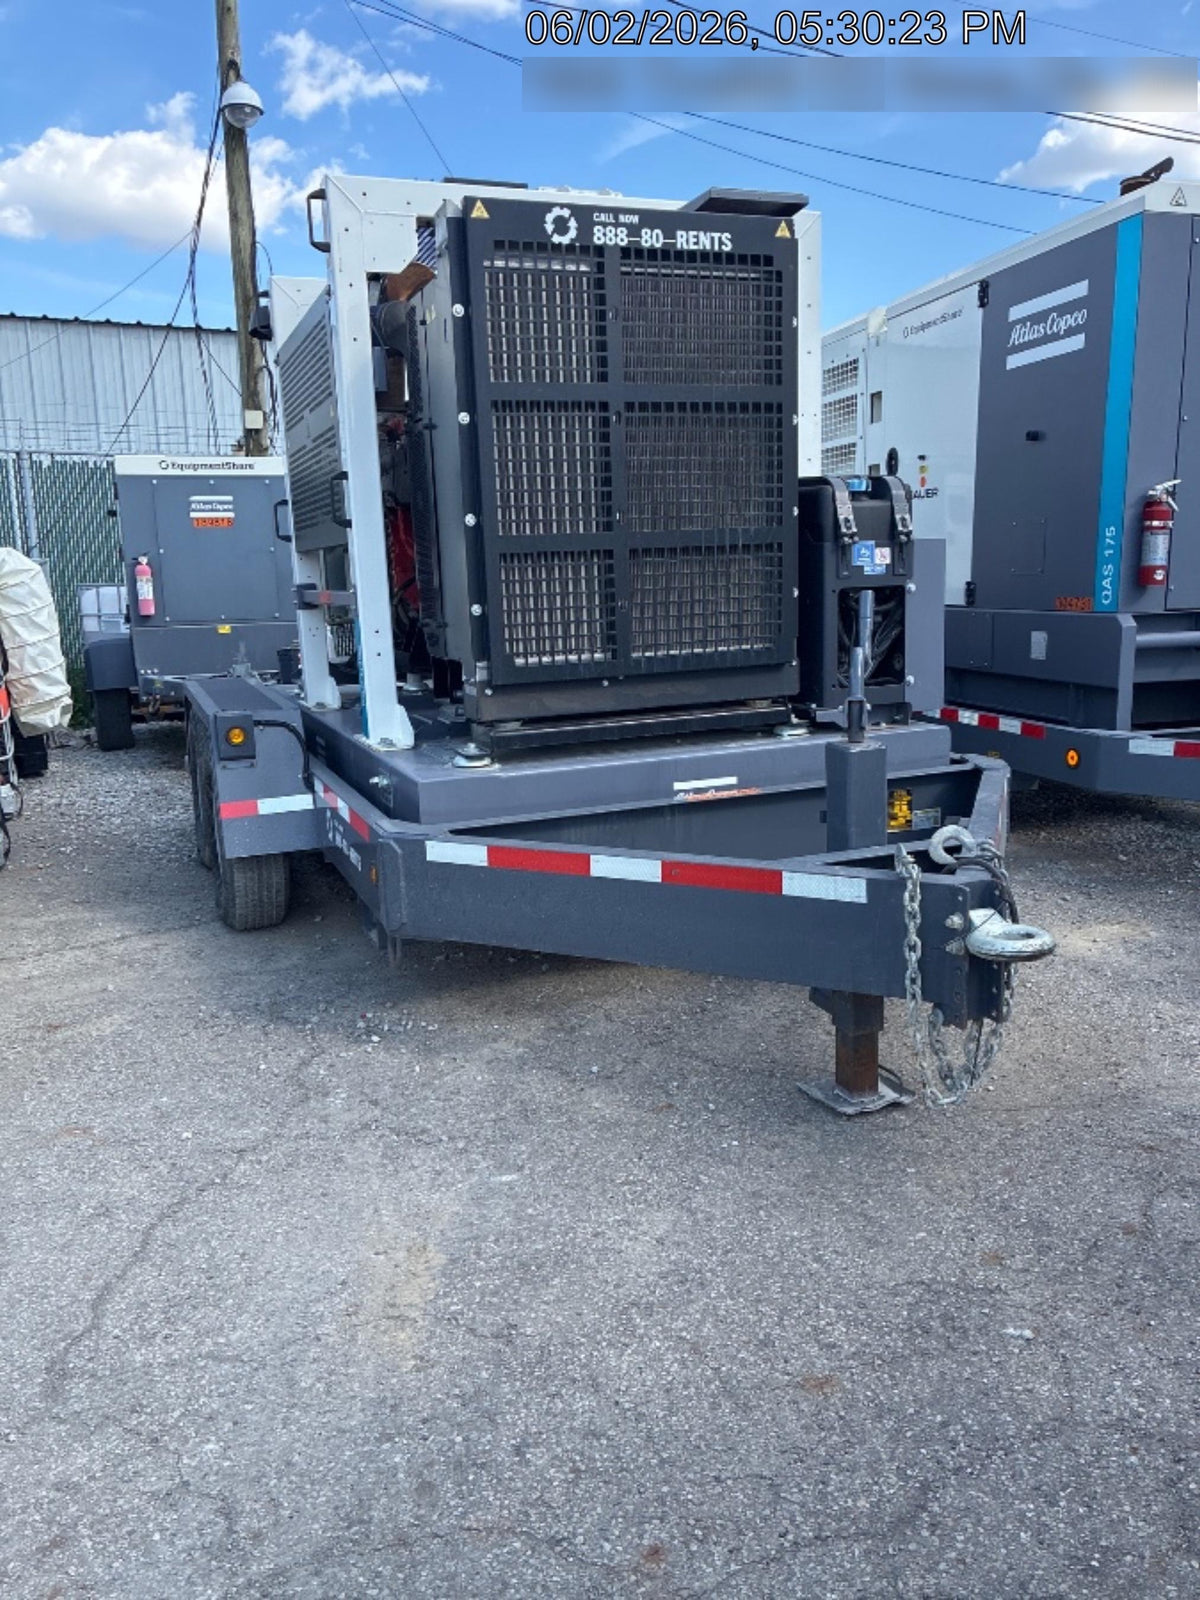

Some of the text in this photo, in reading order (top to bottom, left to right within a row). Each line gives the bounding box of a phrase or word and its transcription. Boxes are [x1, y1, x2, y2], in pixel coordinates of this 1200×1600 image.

[593, 212, 640, 225] CALL NOW
[592, 225, 733, 252] 888-80-RENTS
[1007, 308, 1088, 348] Atlas Copco
[171, 461, 255, 472] EquipmentShare
[1101, 563, 1115, 605] QAS
